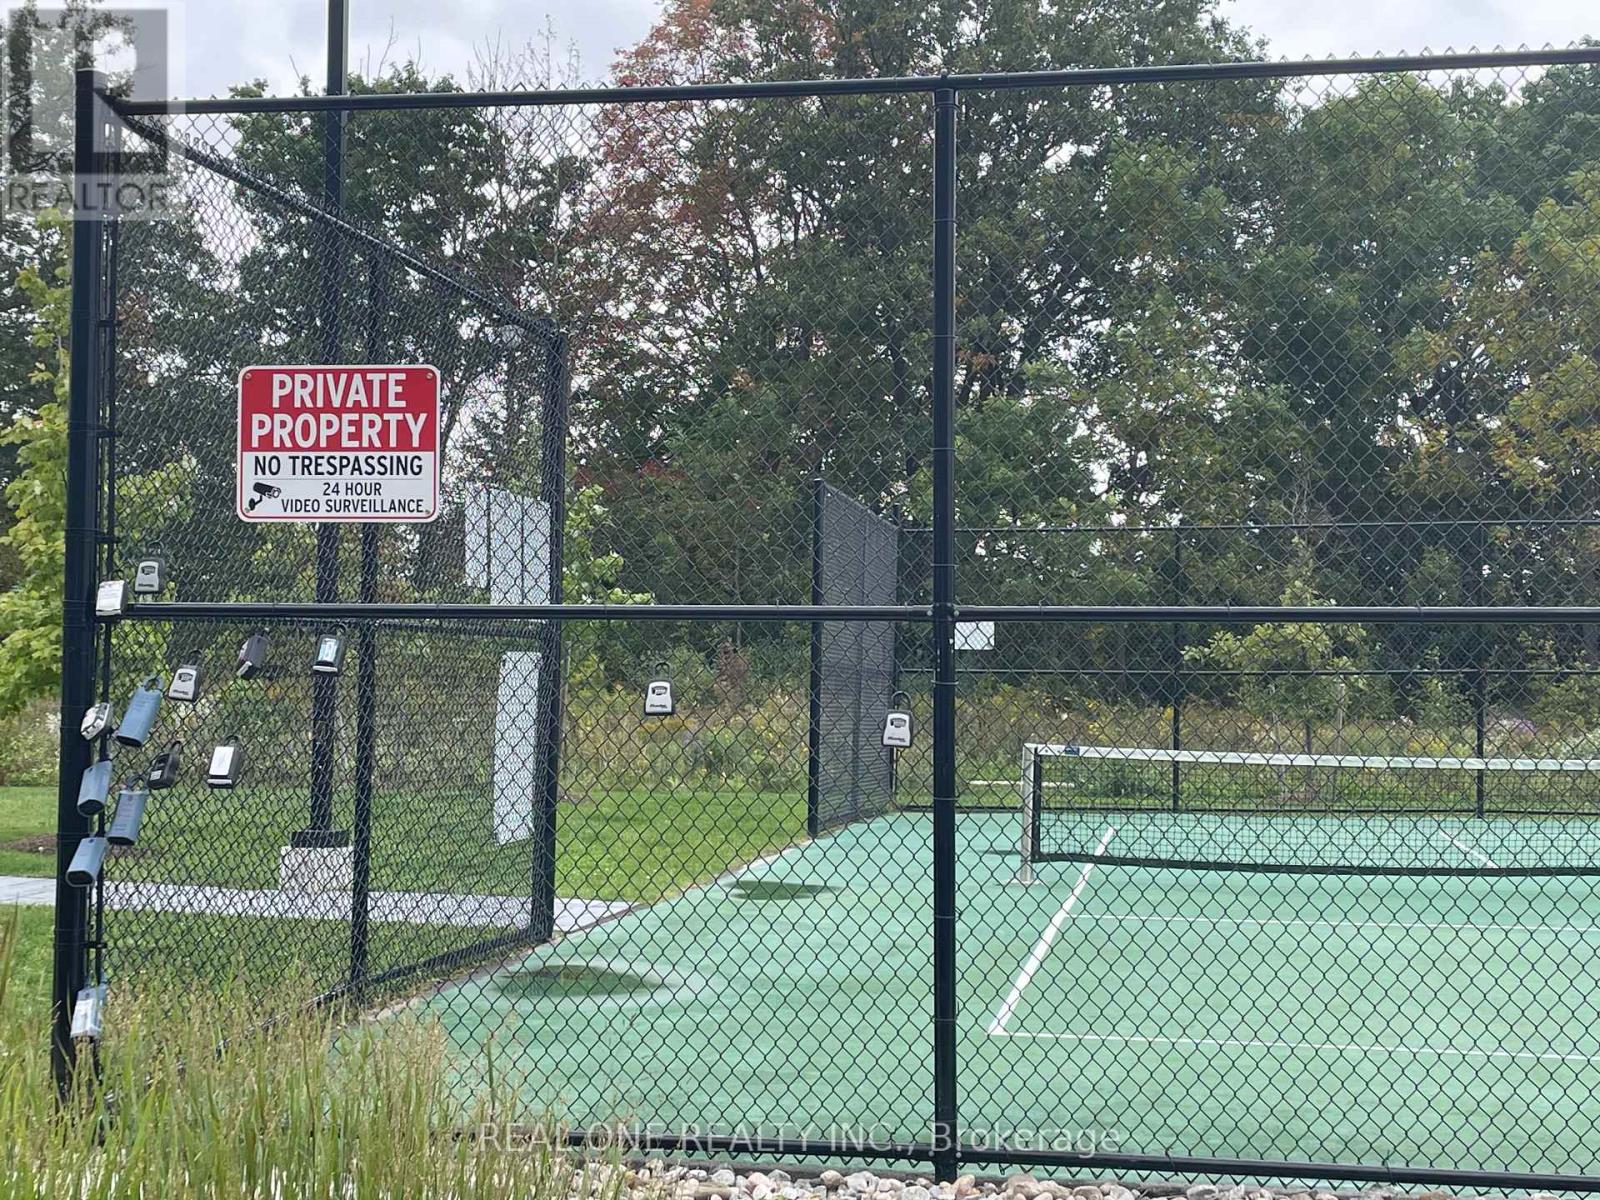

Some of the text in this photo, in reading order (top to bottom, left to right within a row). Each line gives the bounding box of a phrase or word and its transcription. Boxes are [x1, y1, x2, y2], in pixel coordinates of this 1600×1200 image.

[272, 373, 407, 408] PRIVATE
[251, 413, 428, 448] PROPERTY
[254, 455, 423, 476] NO TRESPASSING
[323, 482, 382, 496] 24 HOUR
[281, 499, 424, 513] VIDEO SURVEILLANCE
